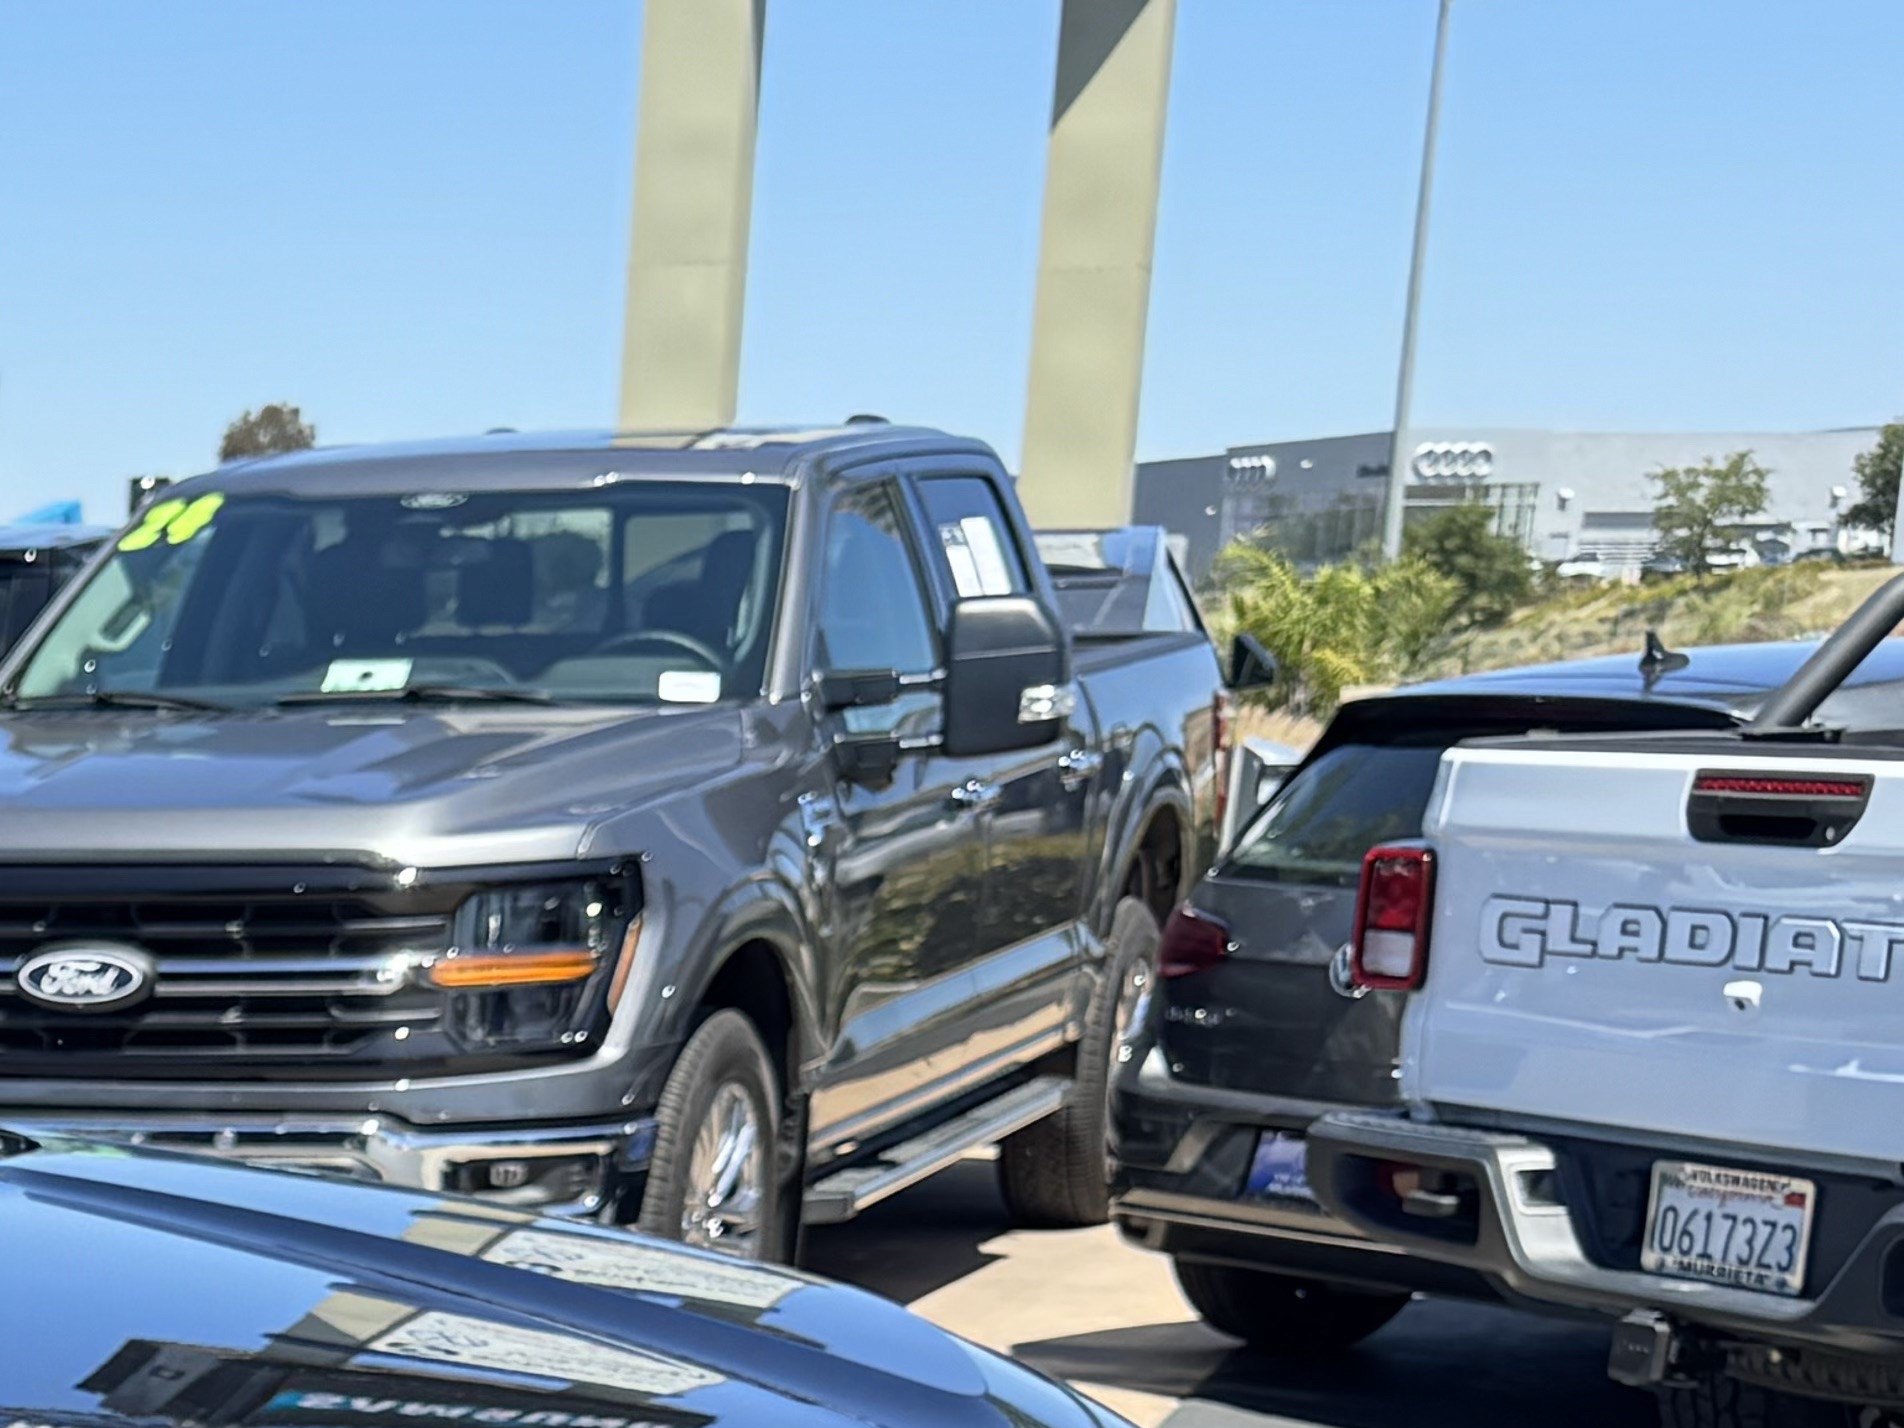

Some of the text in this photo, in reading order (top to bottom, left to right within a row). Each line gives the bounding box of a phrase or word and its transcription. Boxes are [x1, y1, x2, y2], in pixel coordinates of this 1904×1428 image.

[38, 959, 122, 996] Ford
[1690, 1169, 1780, 1192] VOLKSWAGEN
[1658, 1205, 1797, 1272] 06173Z3
[1677, 1259, 1766, 1285] MURRIETA
